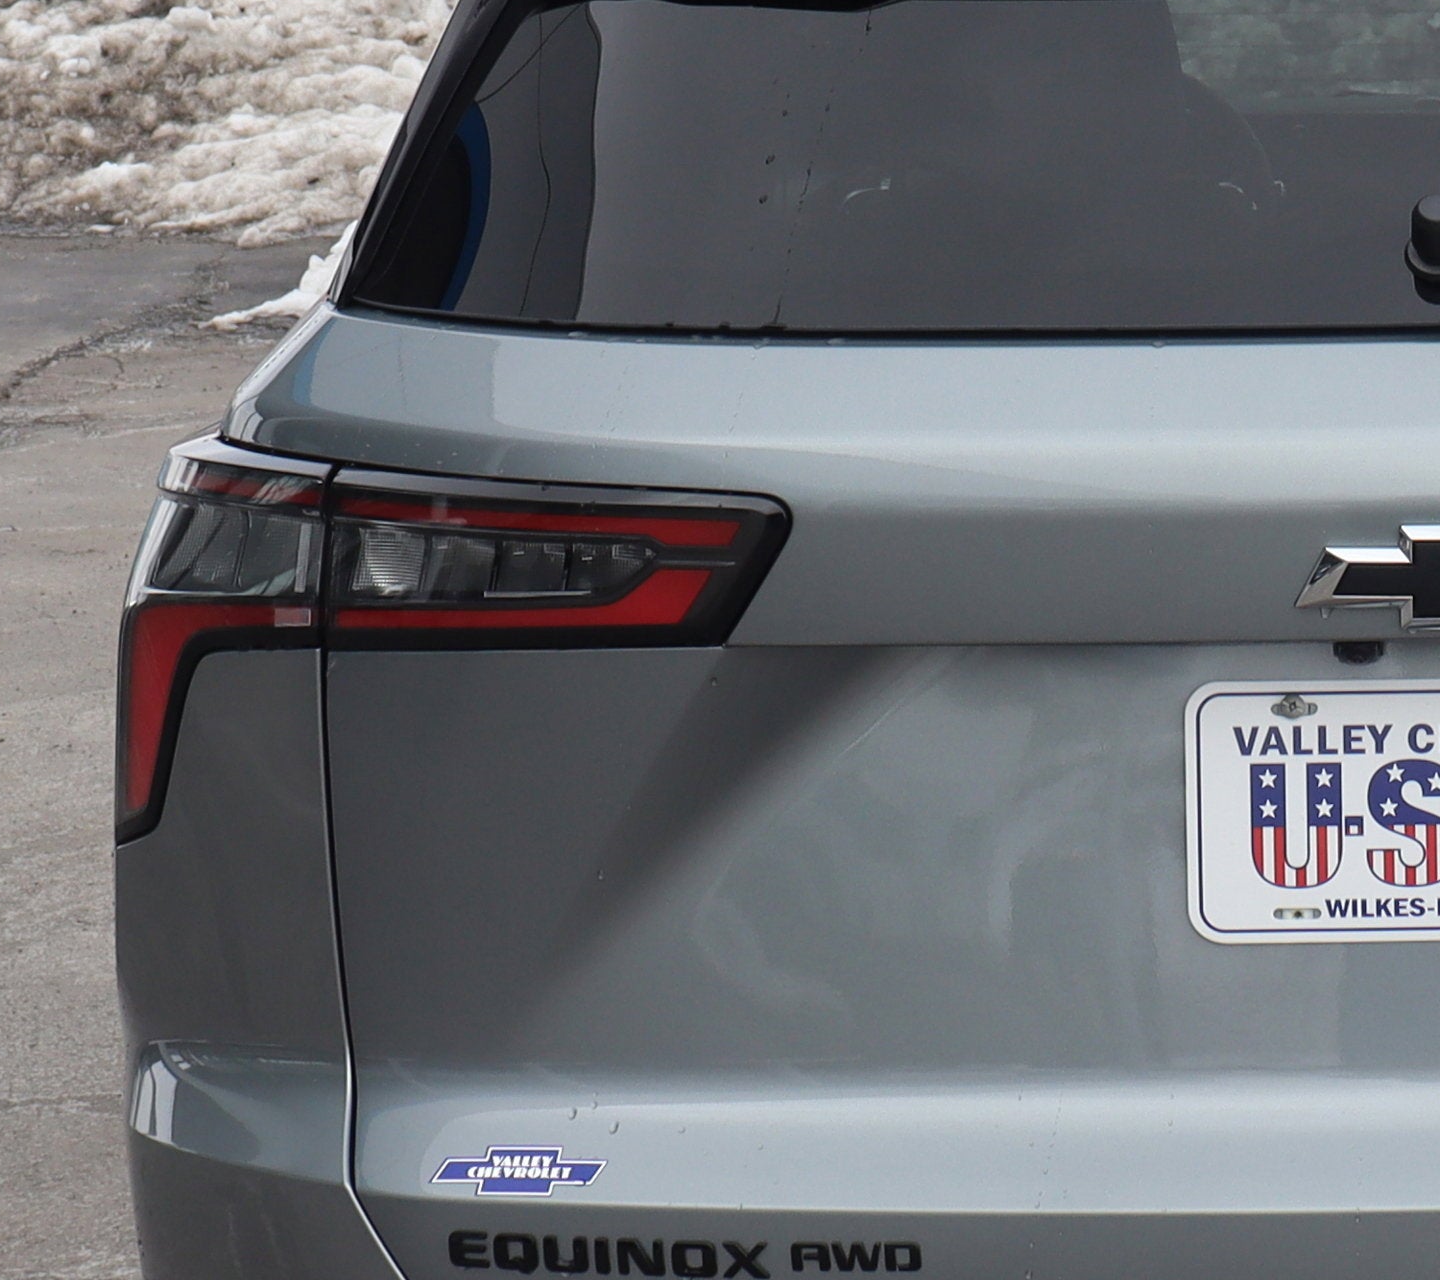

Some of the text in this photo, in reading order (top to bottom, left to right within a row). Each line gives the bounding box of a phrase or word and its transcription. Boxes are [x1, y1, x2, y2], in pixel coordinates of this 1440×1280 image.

[1232, 724, 1393, 757] VALLEY
[467, 1165, 573, 1180] CHEVROLET
[492, 1155, 553, 1168] VALLEY
[448, 1229, 923, 1280] EQUINOX AWD
